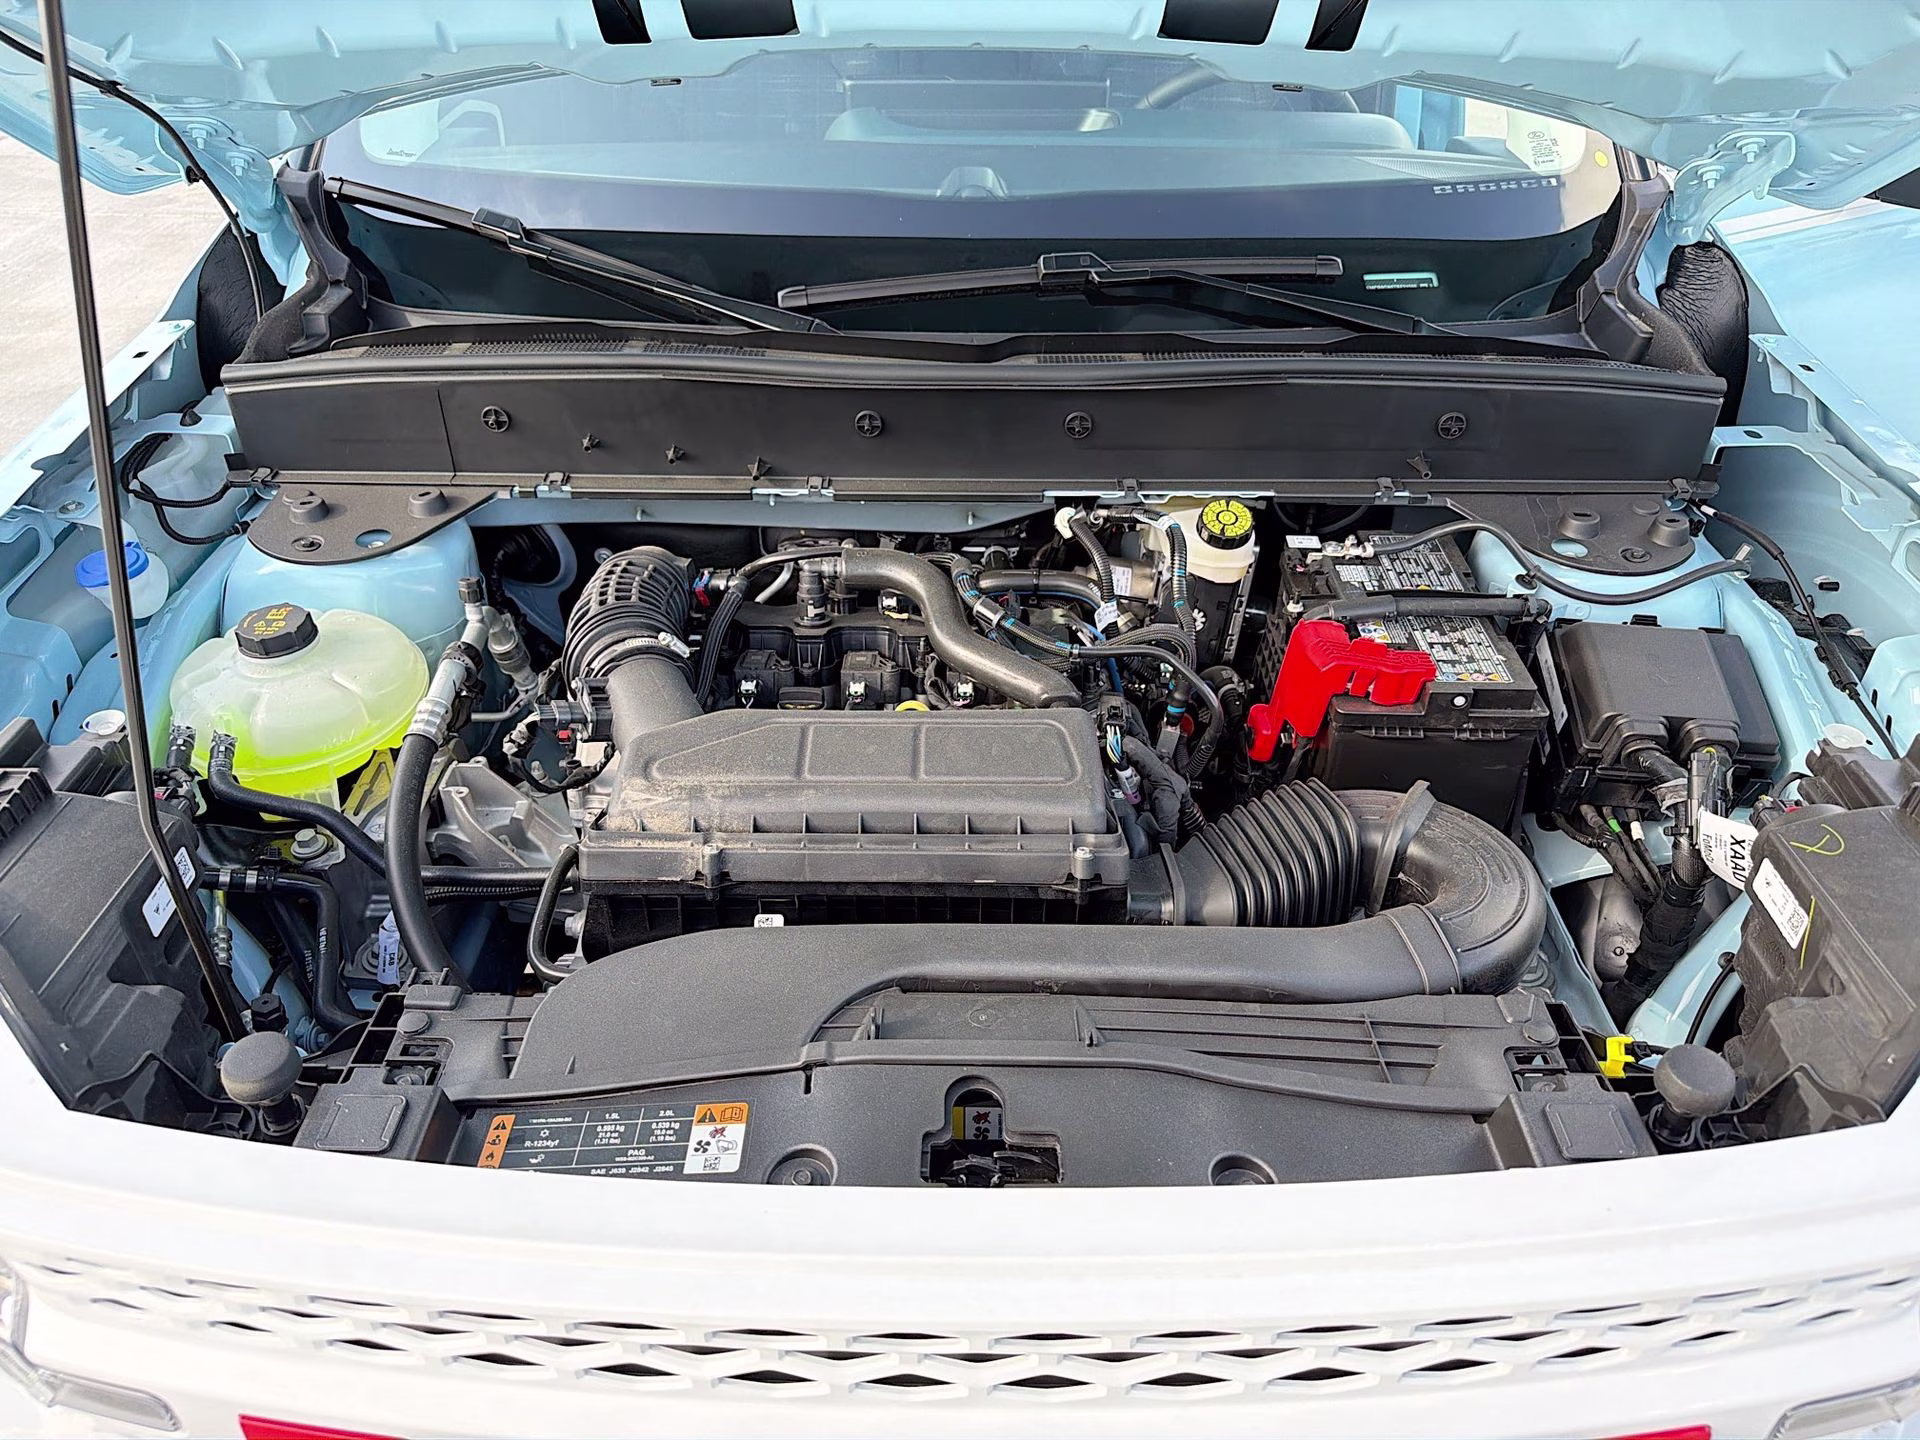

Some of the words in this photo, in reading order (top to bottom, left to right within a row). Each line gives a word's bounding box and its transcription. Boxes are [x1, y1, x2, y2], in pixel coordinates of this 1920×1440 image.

[605, 1112, 620, 1120] 1.5L
[658, 1109, 675, 1117] 2.0L
[615, 1124, 625, 1132] kg
[670, 1121, 680, 1130] kg
[524, 1139, 560, 1147] R-1234yf
